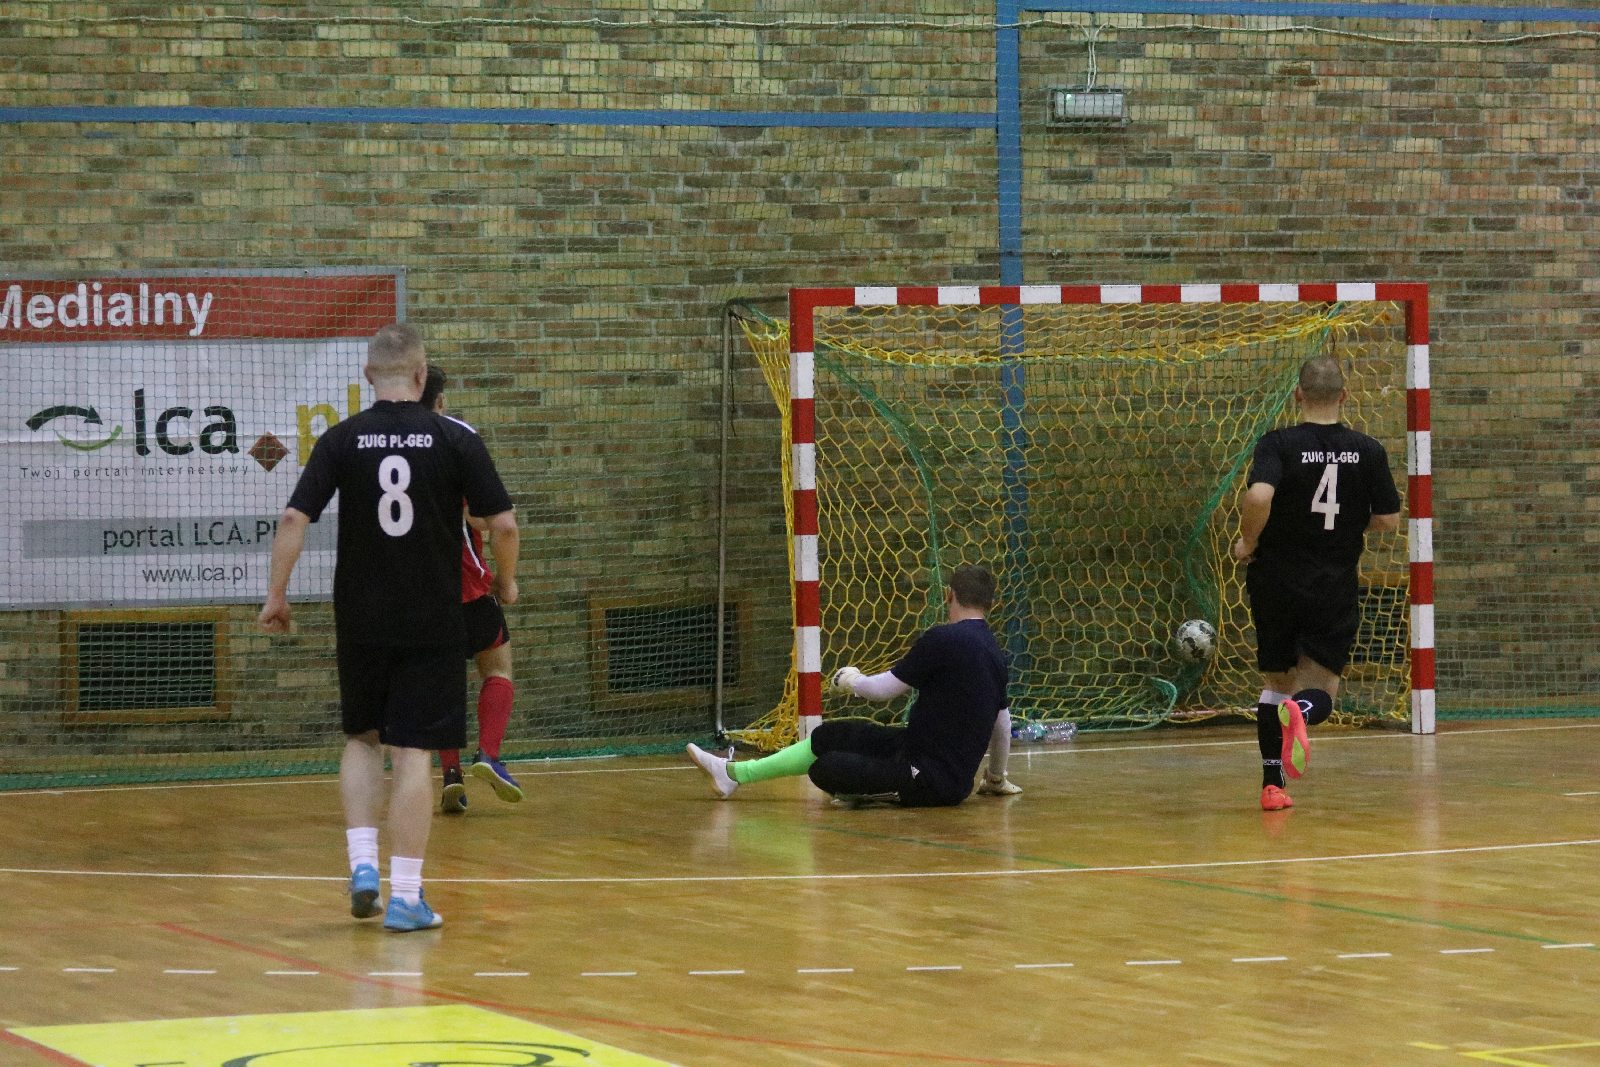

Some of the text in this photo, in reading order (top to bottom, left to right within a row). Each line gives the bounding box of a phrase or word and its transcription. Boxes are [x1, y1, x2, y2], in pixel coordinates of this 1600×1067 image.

[0, 283, 213, 336] Medialny
[357, 433, 433, 449] ZUIG PL-GEO
[1302, 451, 1360, 463] ZUIG PL-GEO
[73, 465, 129, 479] portal
[141, 465, 249, 476] internetowy
[378, 455, 414, 537] 8
[1311, 464, 1340, 530] 4
[103, 522, 184, 554] portal
[142, 562, 249, 584] www.lca.pl
